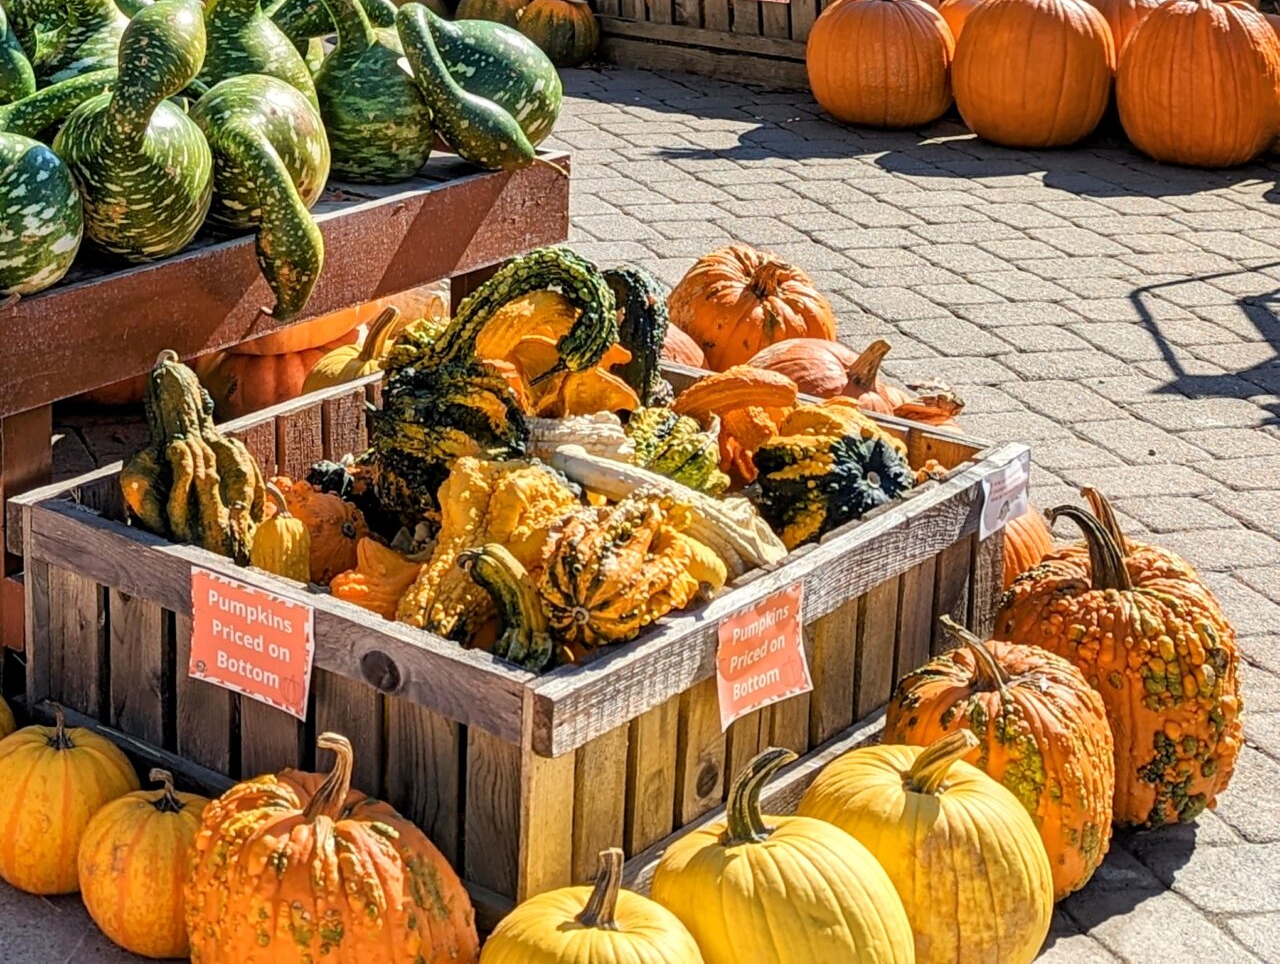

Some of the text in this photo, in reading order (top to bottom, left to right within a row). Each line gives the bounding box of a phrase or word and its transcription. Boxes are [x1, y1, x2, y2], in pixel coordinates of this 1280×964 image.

[208, 589, 293, 634] Pumpkins
[732, 604, 790, 646] Pumpkins
[212, 619, 290, 662] Priced on
[729, 634, 786, 674] Priced on
[216, 650, 280, 689] Bottom
[732, 667, 781, 701] Bottom
